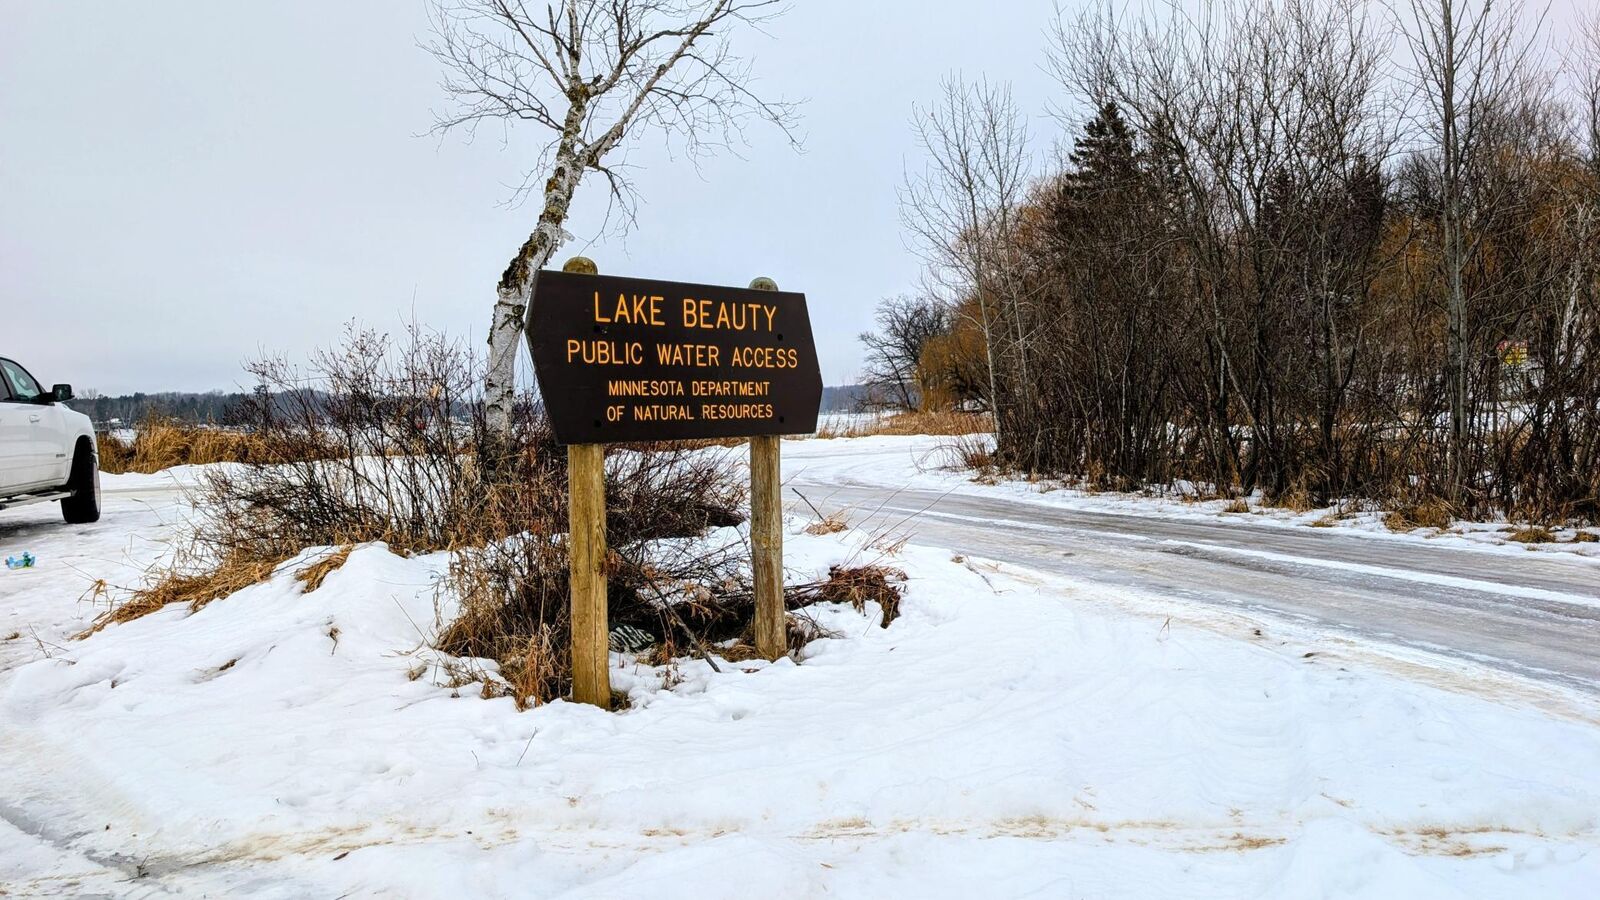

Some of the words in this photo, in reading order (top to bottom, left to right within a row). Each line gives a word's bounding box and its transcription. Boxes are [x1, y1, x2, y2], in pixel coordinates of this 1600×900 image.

[594, 291, 666, 326] LAKE
[683, 298, 777, 332] BEAUTY
[567, 339, 643, 365] PUBLIC
[656, 344, 720, 367] WATER
[731, 346, 798, 369] ACCESS
[608, 380, 684, 396] MINNESOTA
[691, 380, 770, 396] DEPARTMENT
[606, 405, 625, 422] OF
[634, 404, 695, 421] NATURAL
[702, 403, 773, 420] RESOURCES
